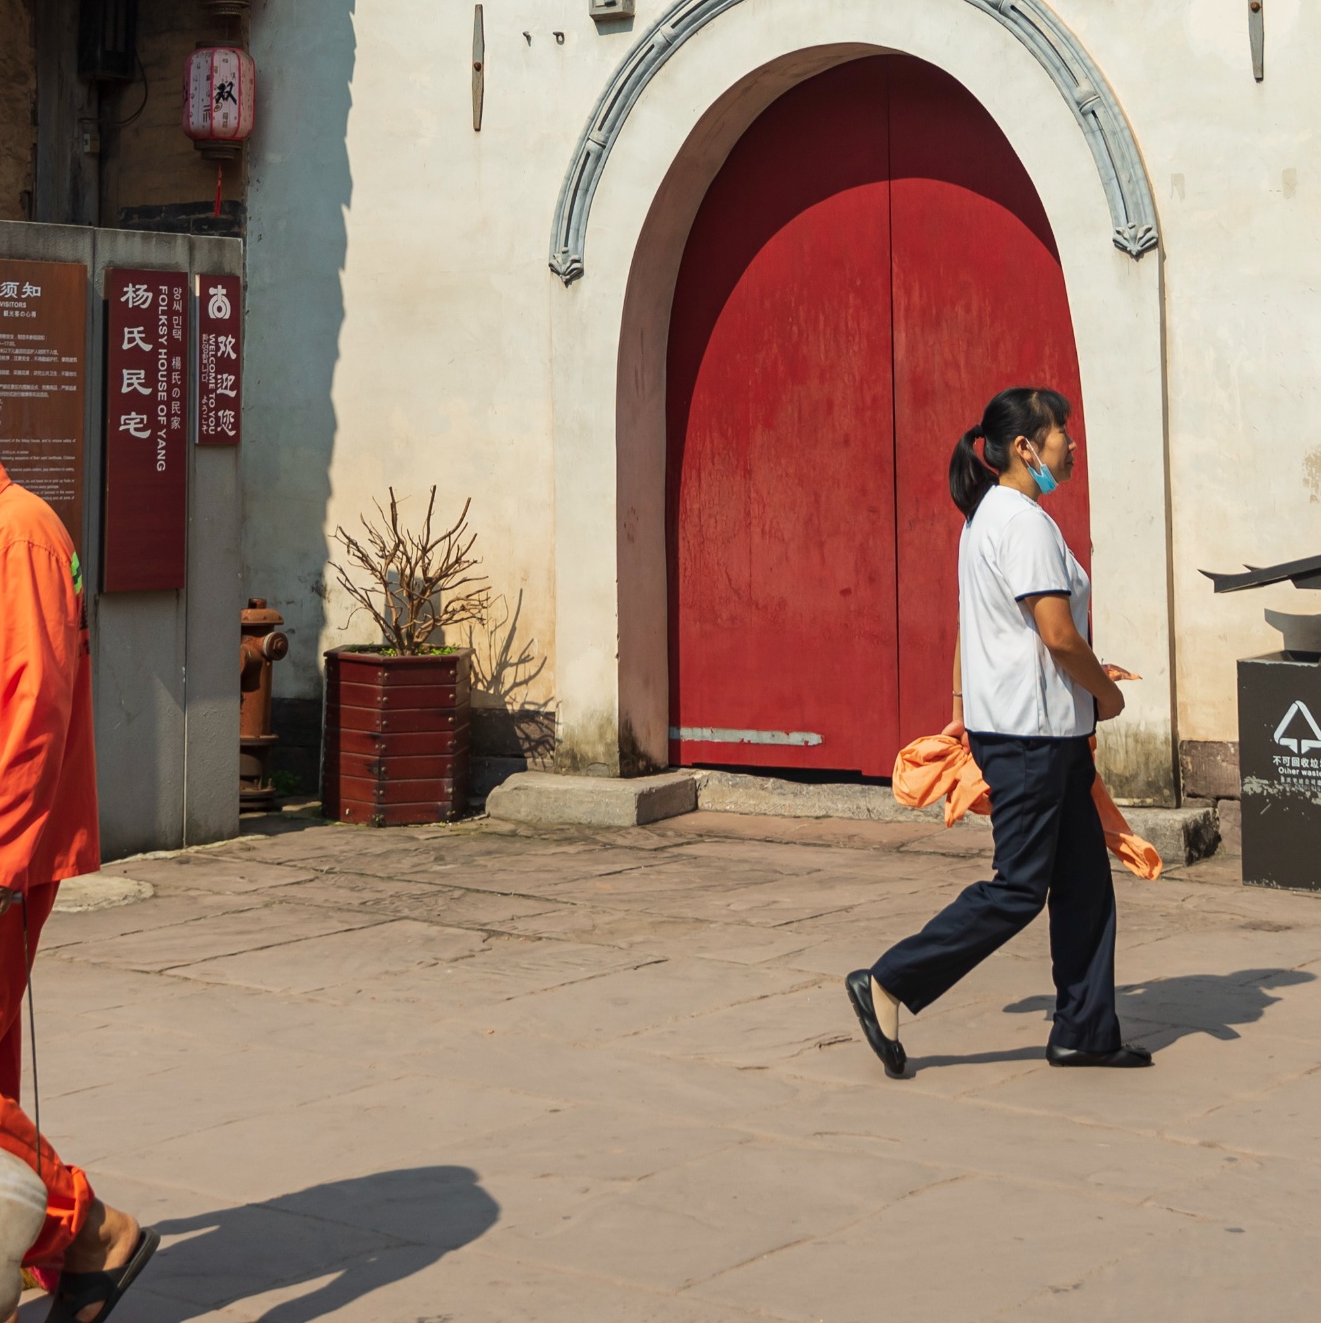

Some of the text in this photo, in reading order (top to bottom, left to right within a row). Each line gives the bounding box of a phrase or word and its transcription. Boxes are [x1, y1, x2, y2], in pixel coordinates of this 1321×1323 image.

[214, 80, 237, 105] 双
[119, 283, 153, 439] 杨氏民宅
[156, 285, 168, 472] FOLKSY HOUSE OF YANG
[208, 334, 216, 435] WELCOME TO YOU
[216, 334, 237, 436] 欢迎您
[1278, 766, 1299, 775] Other
